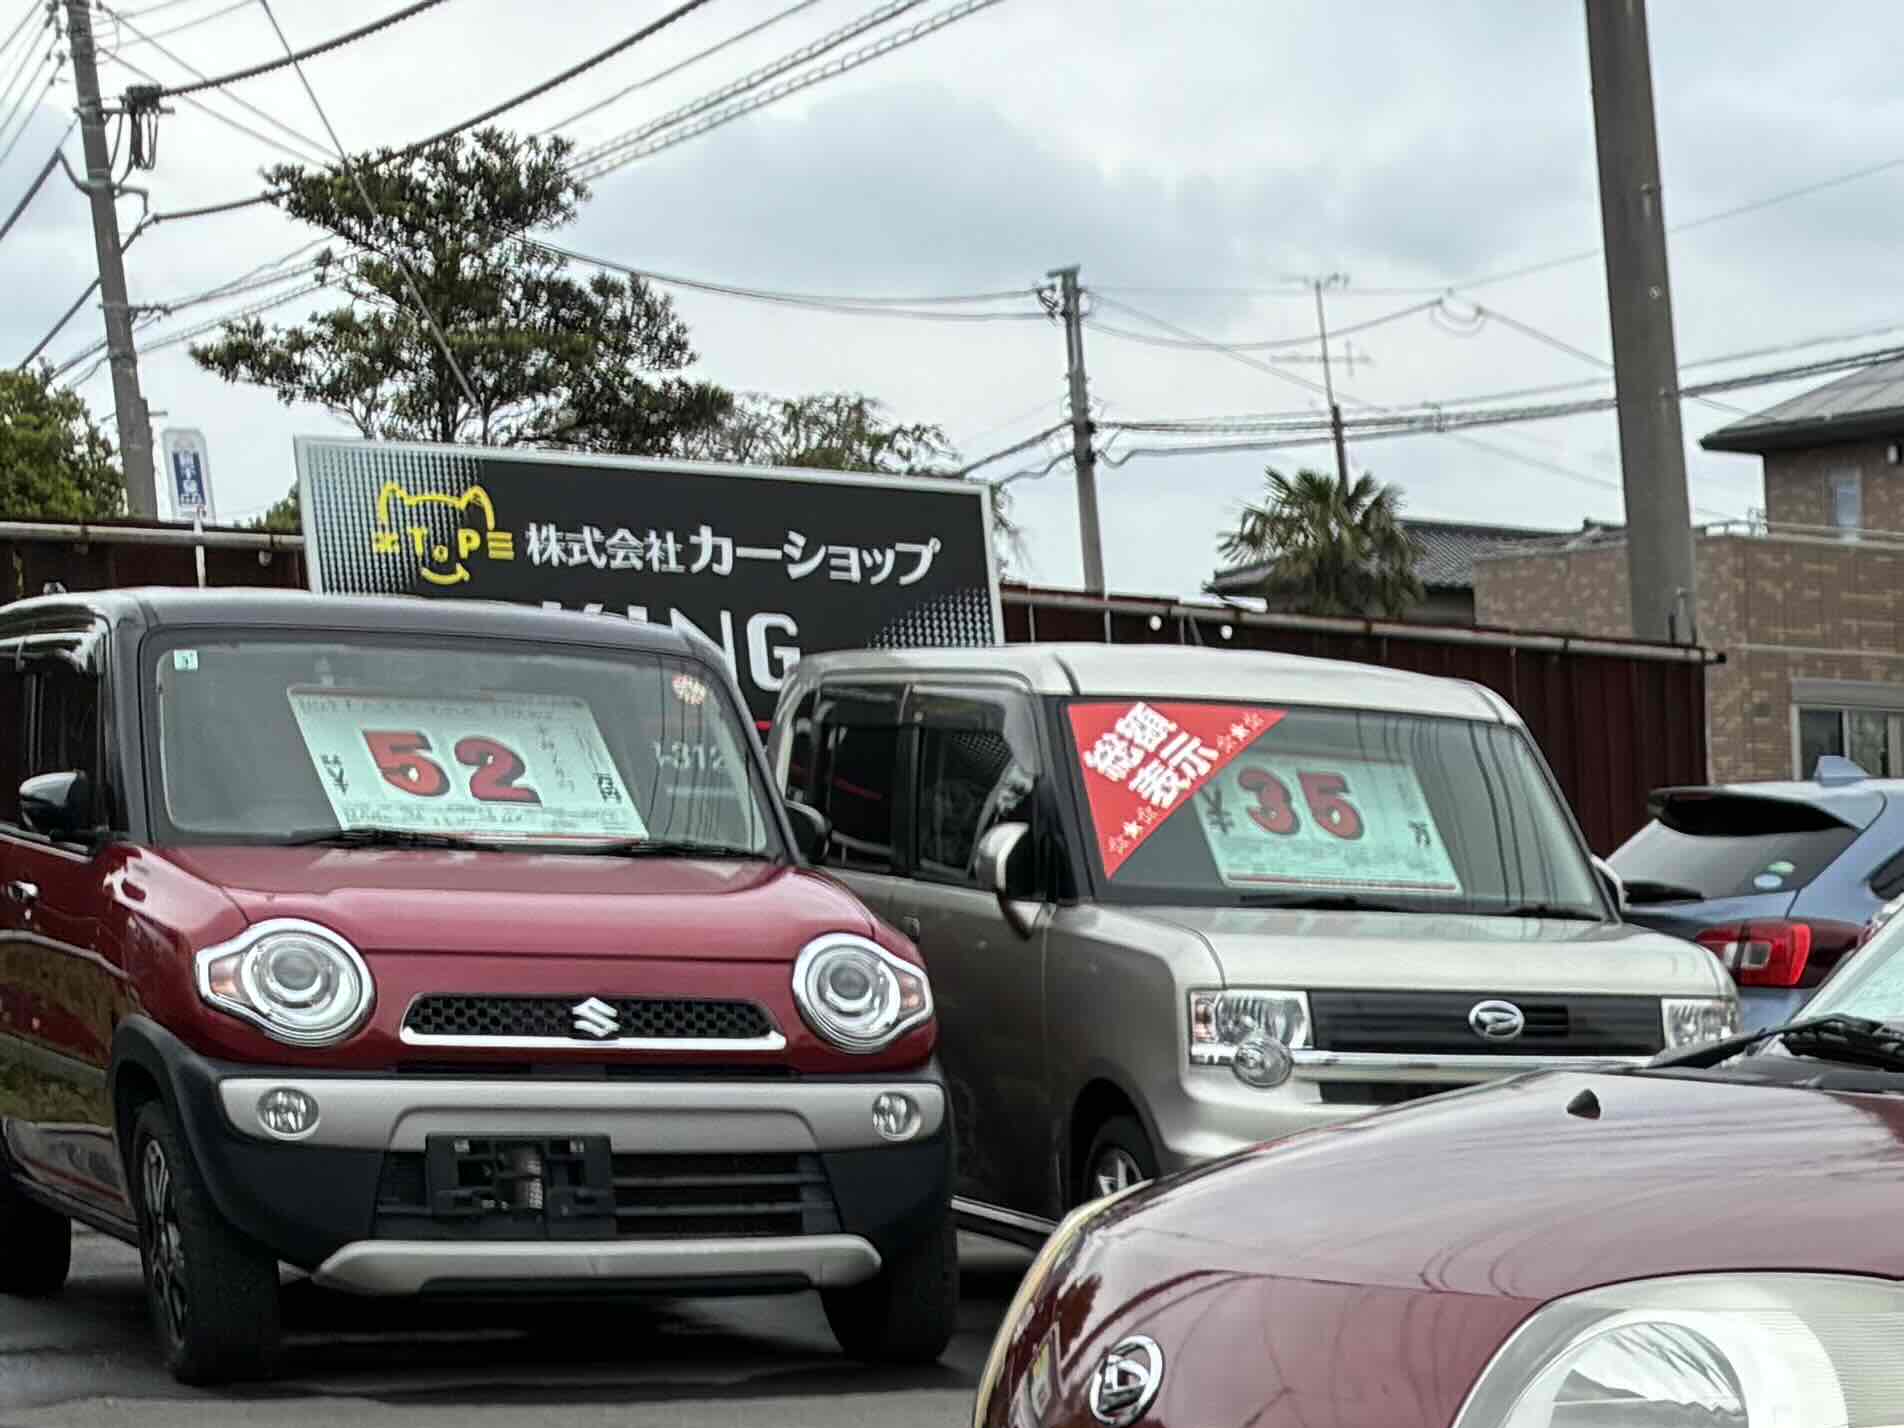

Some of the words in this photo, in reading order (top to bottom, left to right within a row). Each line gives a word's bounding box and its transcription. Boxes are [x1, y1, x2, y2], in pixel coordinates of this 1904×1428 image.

[525, 522, 941, 586] 株式会社カーショップ
[361, 729, 543, 808] 52
[1237, 767, 1365, 840] 35
